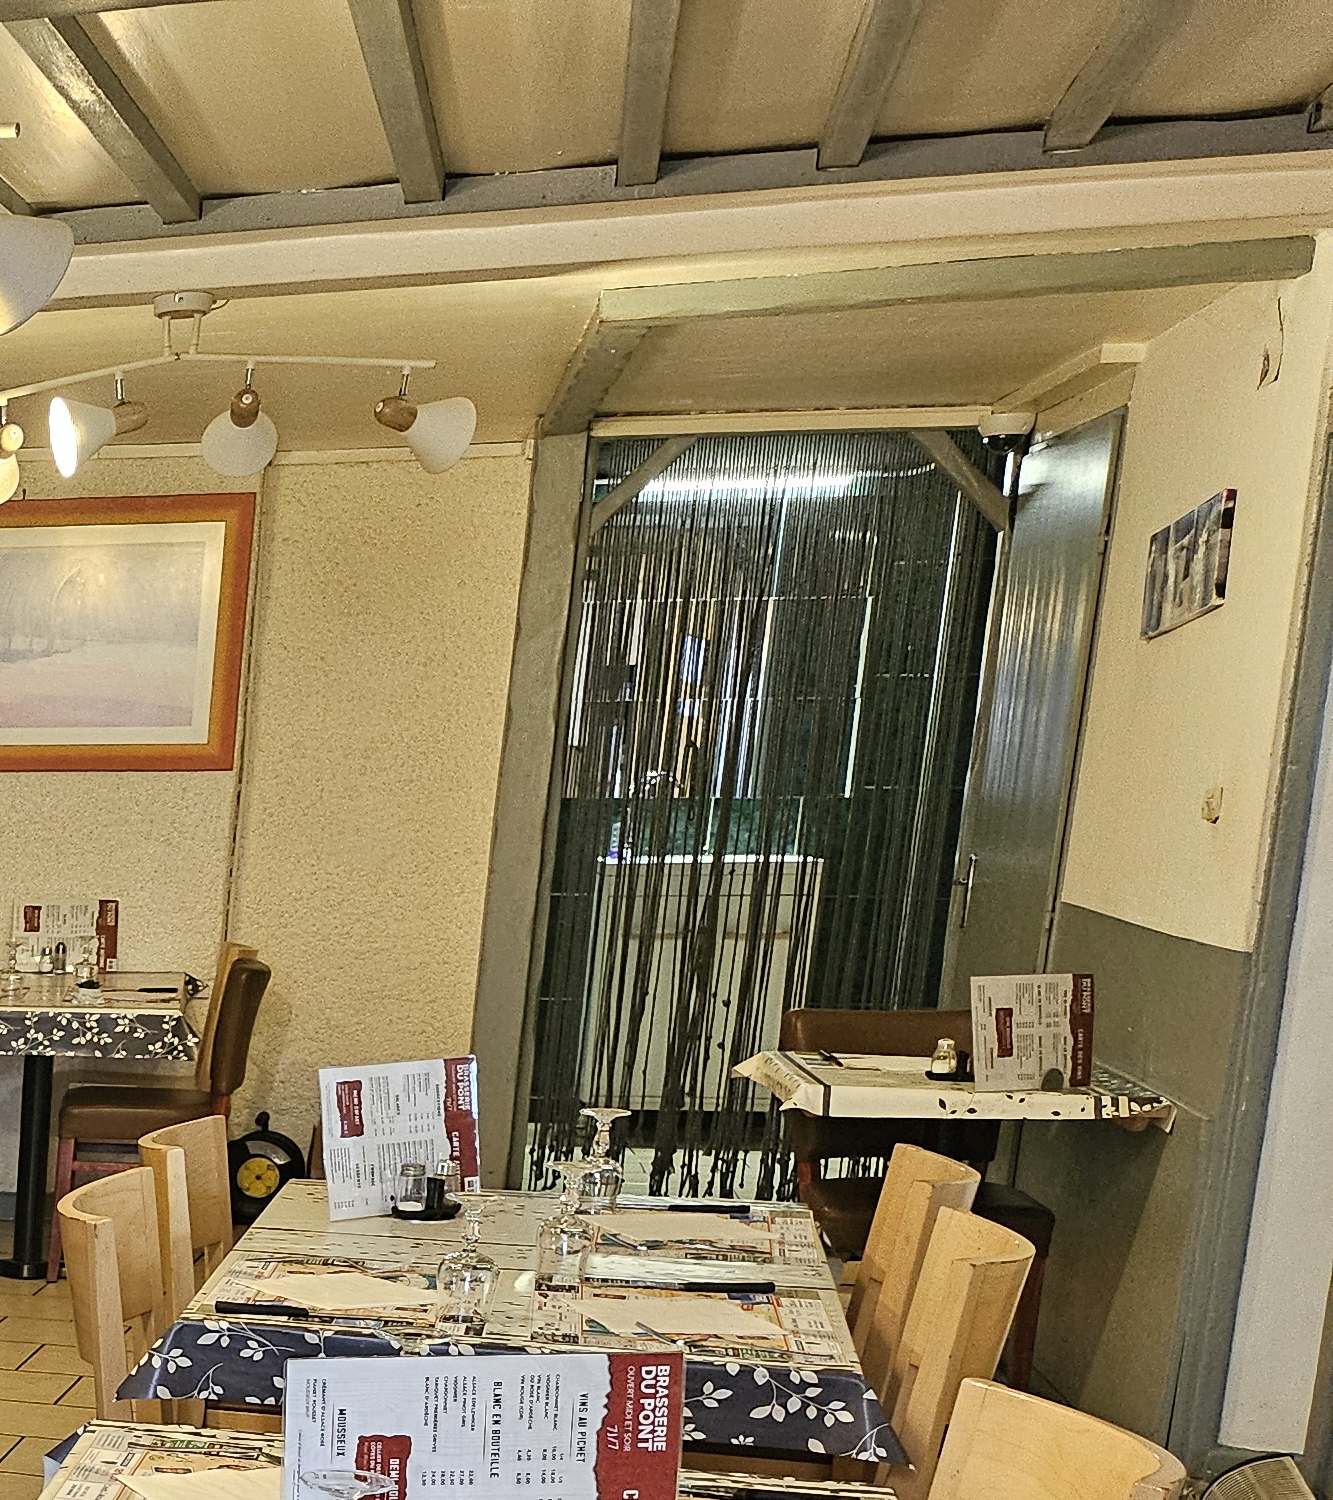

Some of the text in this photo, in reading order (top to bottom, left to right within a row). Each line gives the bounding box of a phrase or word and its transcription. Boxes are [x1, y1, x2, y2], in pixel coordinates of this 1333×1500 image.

[456, 1083, 464, 1110] PONT
[451, 1131, 459, 1156] CARTE
[335, 1408, 347, 1457] MOUSSEUX
[489, 1380, 503, 1478] BLANC EN BOUTEILLE
[575, 1392, 588, 1463] VINS AU PICHET
[621, 1365, 635, 1451] OUVERT MIDI ET SOIR
[636, 1365, 656, 1451] DU PONT
[652, 1365, 670, 1451] BRASSERIE
[388, 1458, 399, 1480] DEMI
